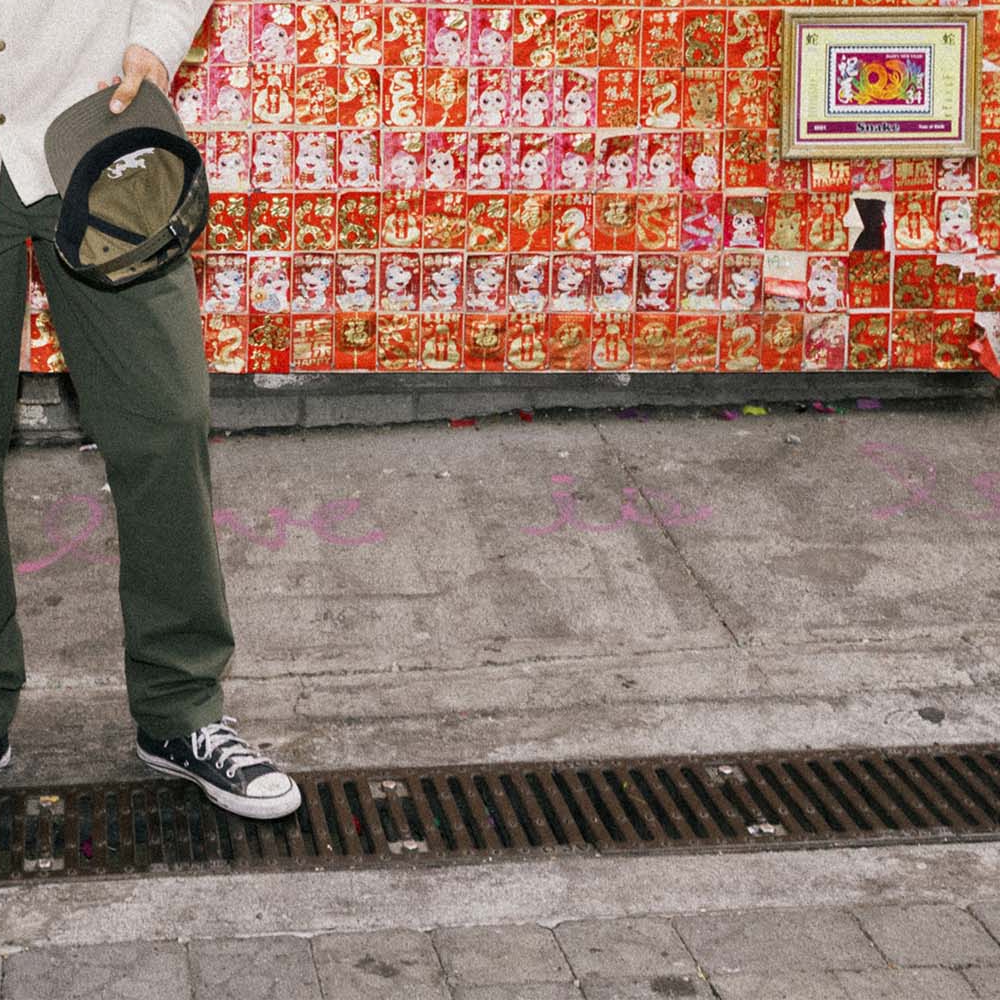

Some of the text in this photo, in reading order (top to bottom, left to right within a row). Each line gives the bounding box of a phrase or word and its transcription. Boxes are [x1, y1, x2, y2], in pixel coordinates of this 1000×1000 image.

[906, 90, 922, 104] 34
[856, 123, 900, 132] Snake
[227, 194, 246, 217] 福
[271, 195, 290, 217] 福
[314, 194, 334, 216] 福
[358, 194, 378, 216] 福
[487, 197, 506, 219] 福
[345, 321, 367, 345] 福
[477, 325, 498, 347] 福
[16, 495, 386, 573] lve
